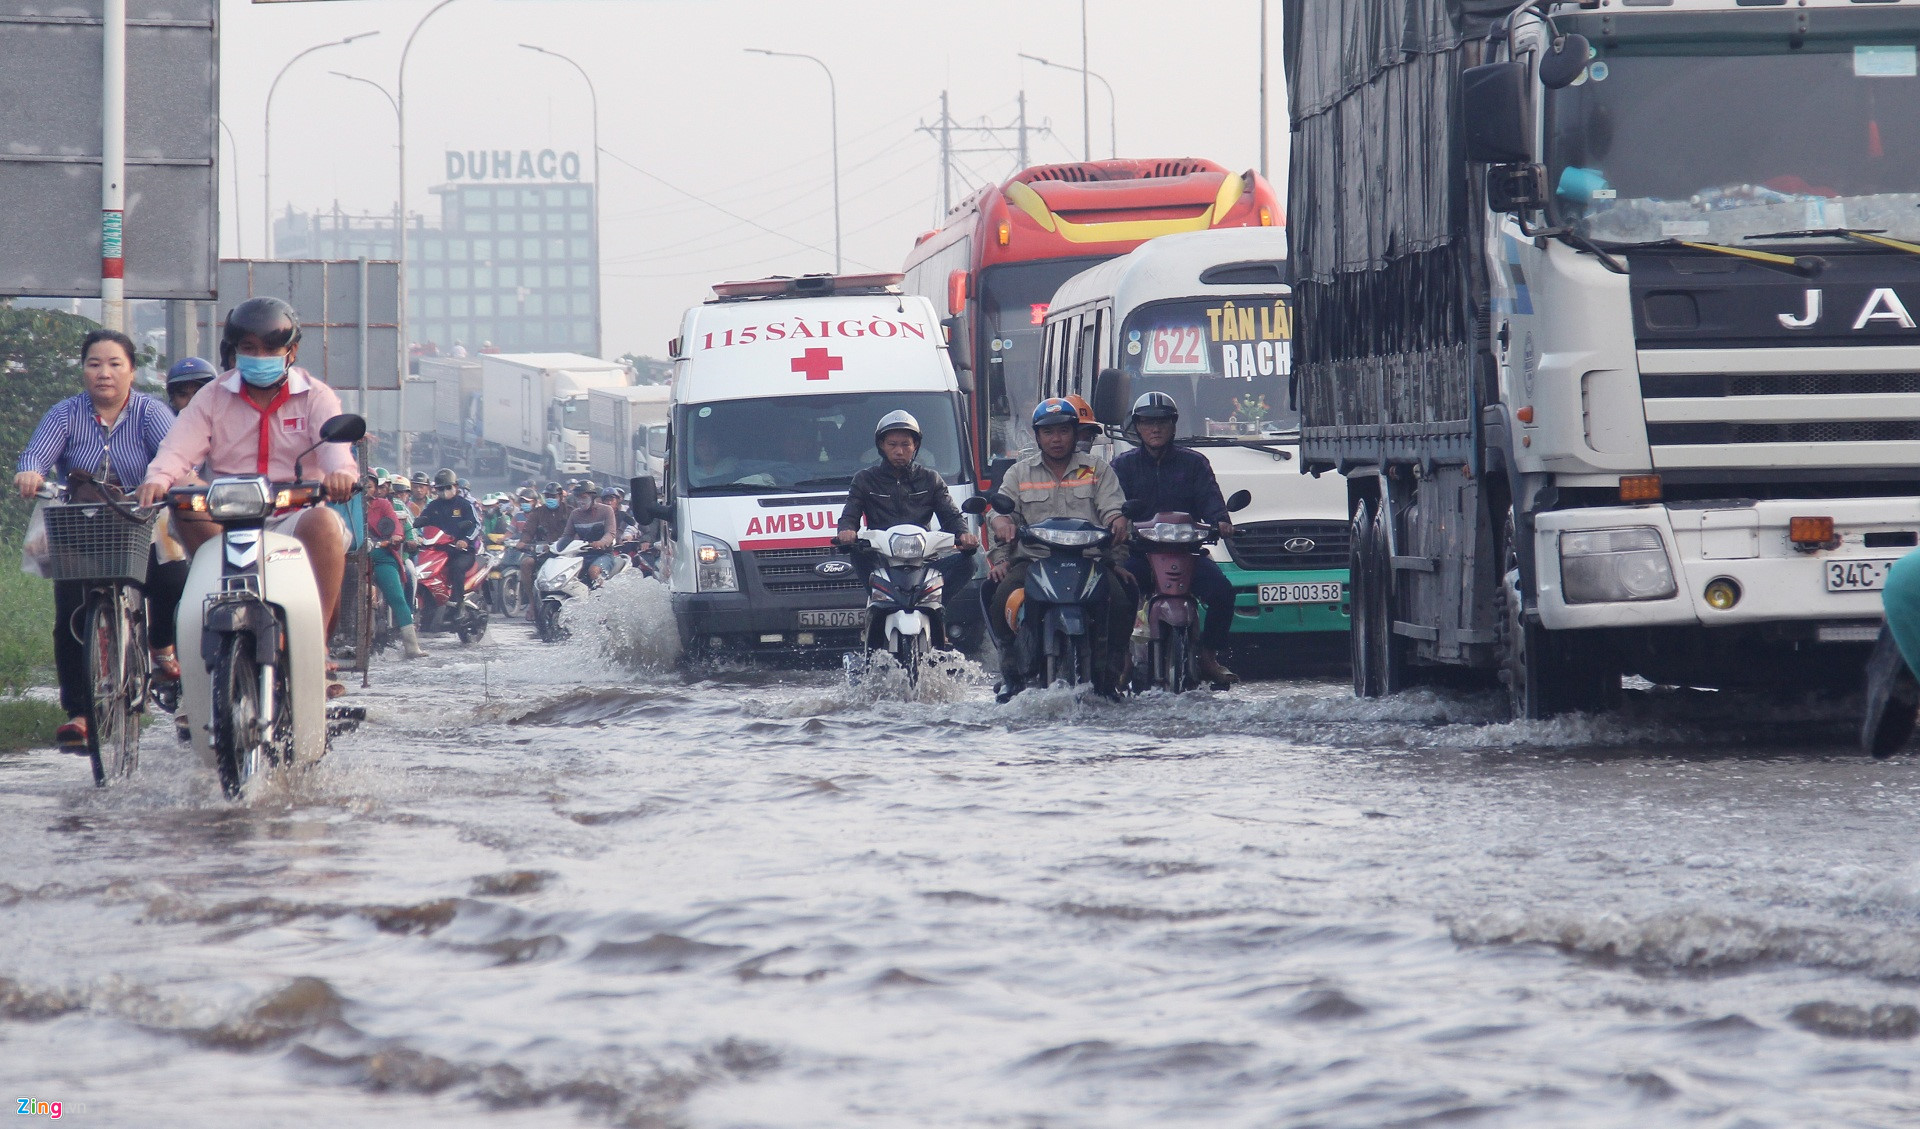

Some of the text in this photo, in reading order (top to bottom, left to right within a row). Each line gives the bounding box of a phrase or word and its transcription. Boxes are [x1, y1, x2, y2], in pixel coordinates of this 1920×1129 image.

[1206, 299, 1293, 341] TÂN LÂ
[701, 326, 758, 350] 115
[1153, 325, 1200, 364] 622
[1222, 341, 1291, 382] RẠCH
[745, 510, 868, 536] AMBUL
[823, 563, 845, 573] Ford
[1261, 584, 1339, 602] 62B-003.58
[801, 611, 866, 628] 51B-076.5
